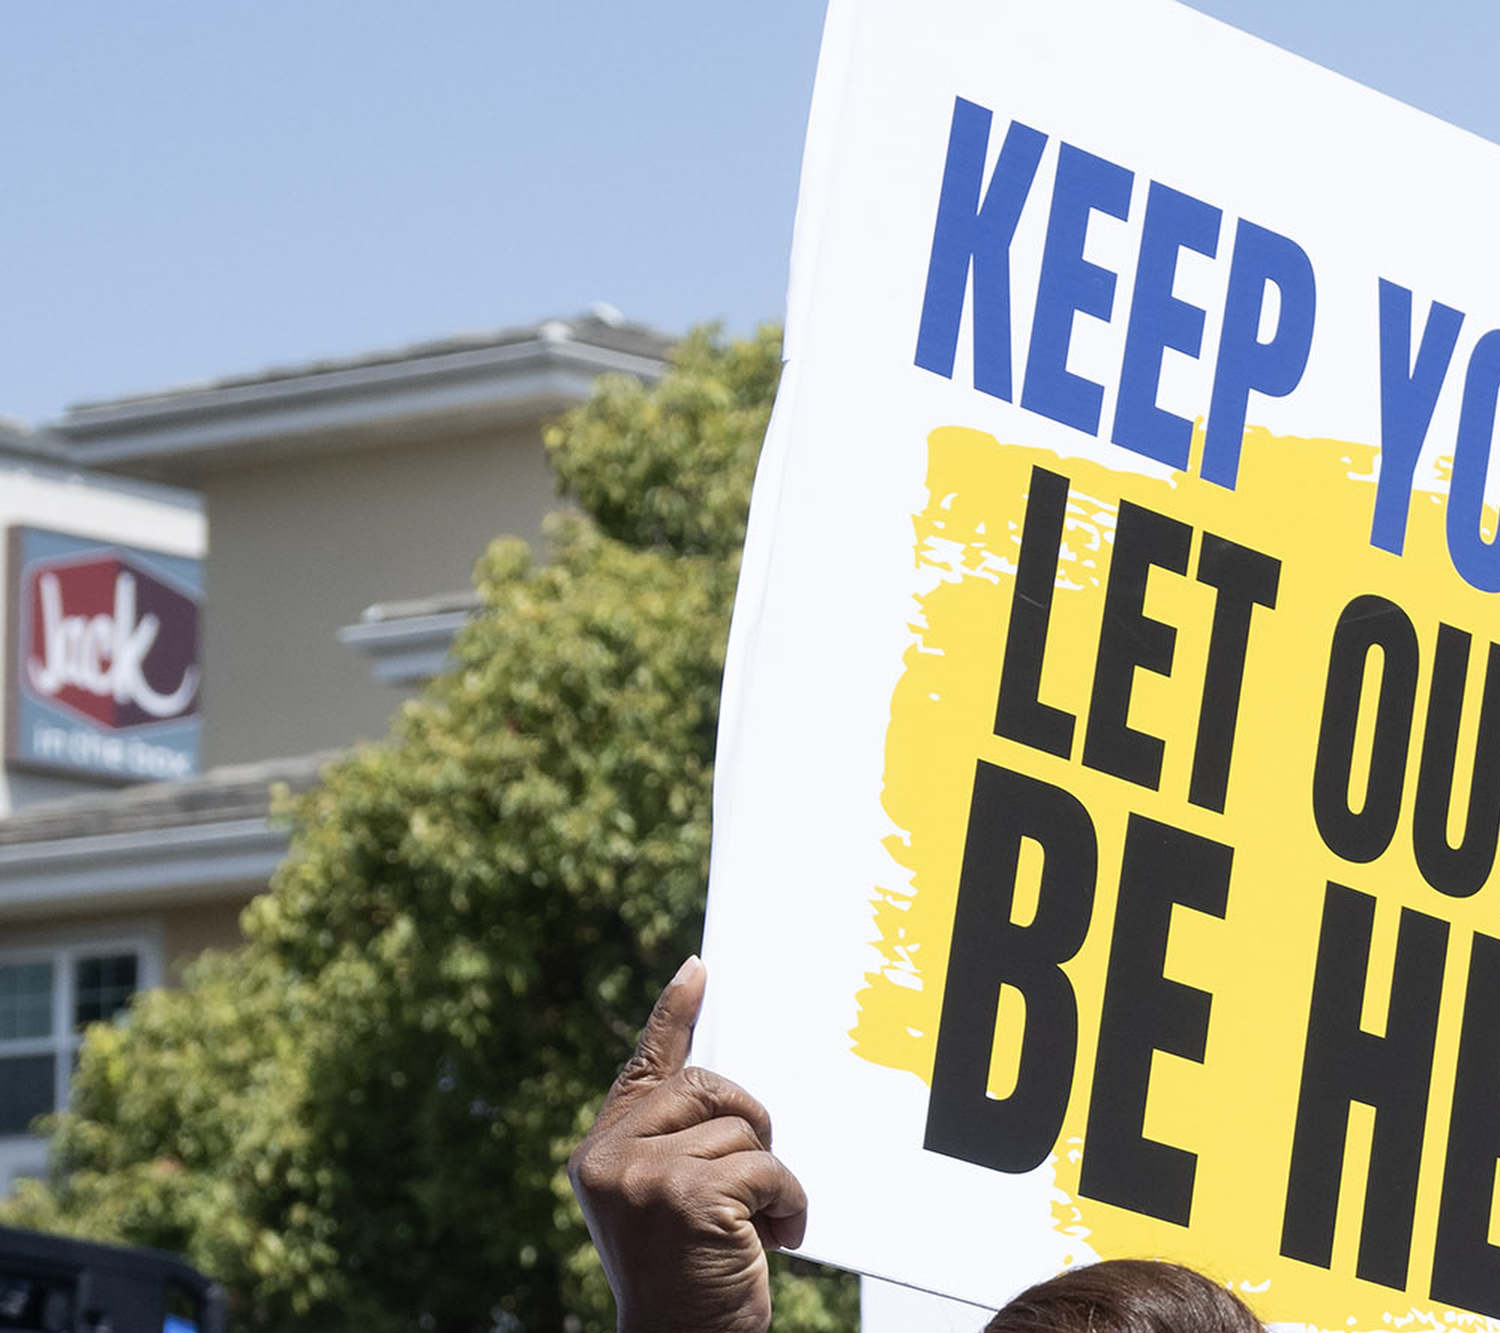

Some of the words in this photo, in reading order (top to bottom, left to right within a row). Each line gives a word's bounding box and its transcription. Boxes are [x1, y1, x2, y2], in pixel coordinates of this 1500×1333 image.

[915, 97, 1315, 490] KEEP
[994, 465, 1281, 814] LET
[923, 759, 1234, 1228] BE
